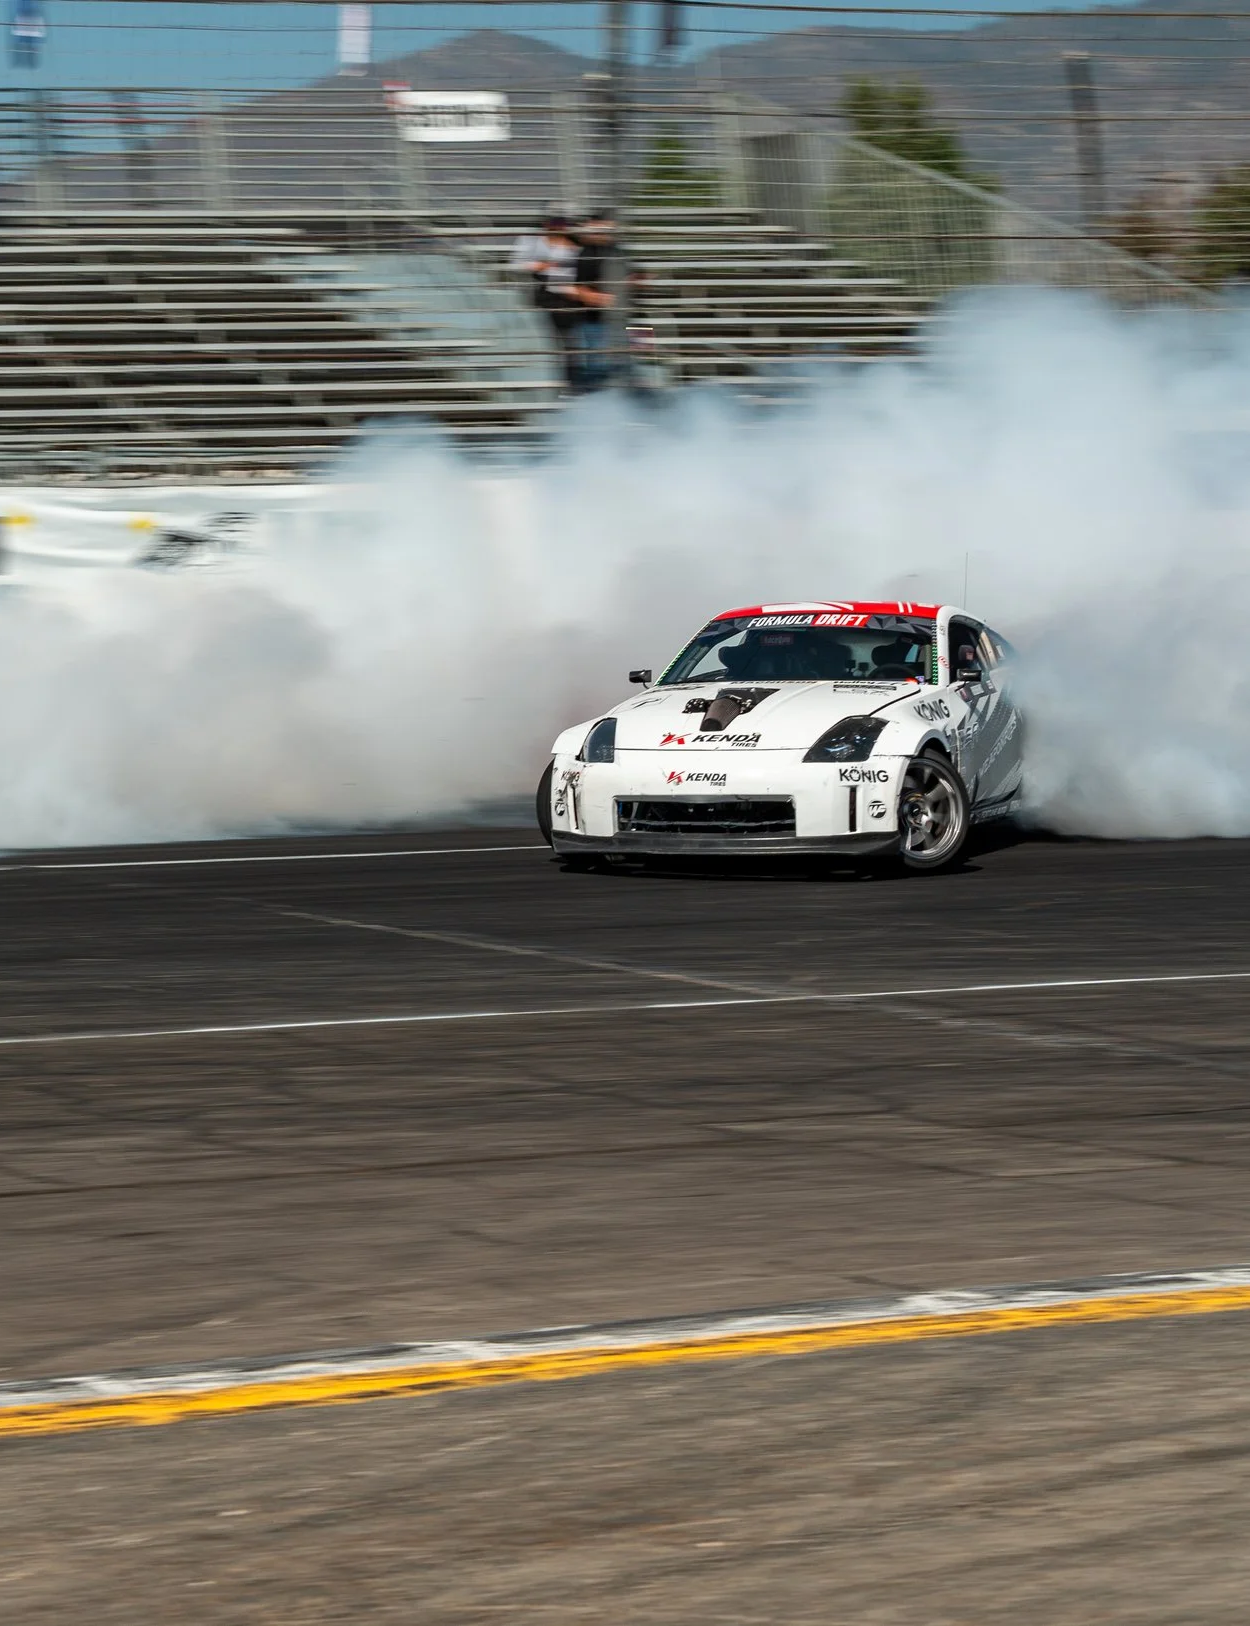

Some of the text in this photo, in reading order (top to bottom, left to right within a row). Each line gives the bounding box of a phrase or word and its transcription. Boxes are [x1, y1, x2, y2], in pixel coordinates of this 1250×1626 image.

[747, 614, 868, 628] FORMULA DRIFT
[913, 698, 951, 722] KÖNIG
[691, 732, 762, 743] KENDA
[685, 773, 727, 782] KENDA
[839, 766, 889, 783] KÖNIG
